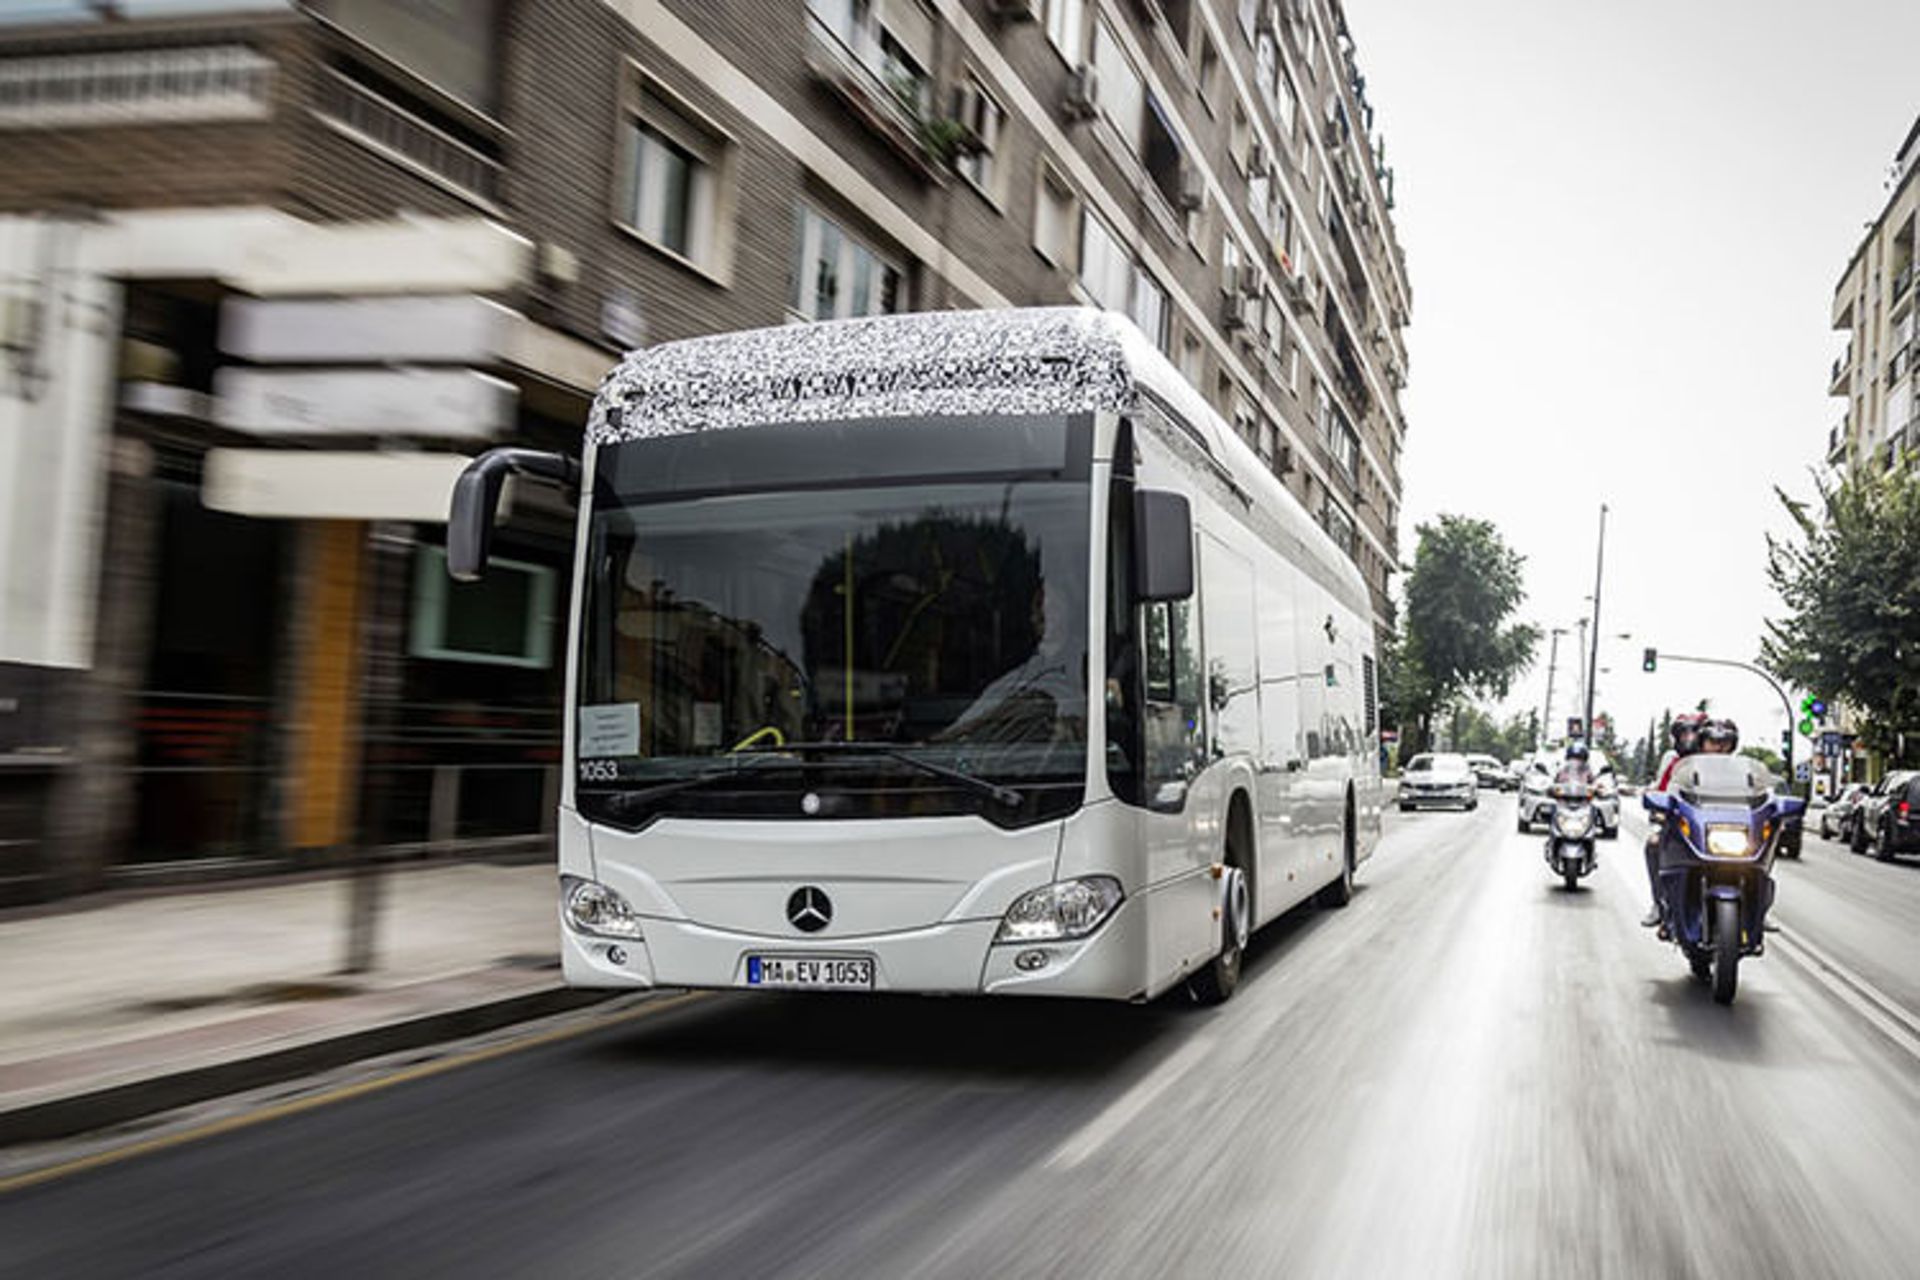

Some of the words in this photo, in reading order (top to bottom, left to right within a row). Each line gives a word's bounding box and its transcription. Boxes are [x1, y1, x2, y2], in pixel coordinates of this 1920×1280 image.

[762, 961, 783, 982] MA
[797, 961, 820, 982] EV
[825, 961, 869, 983] 1053
